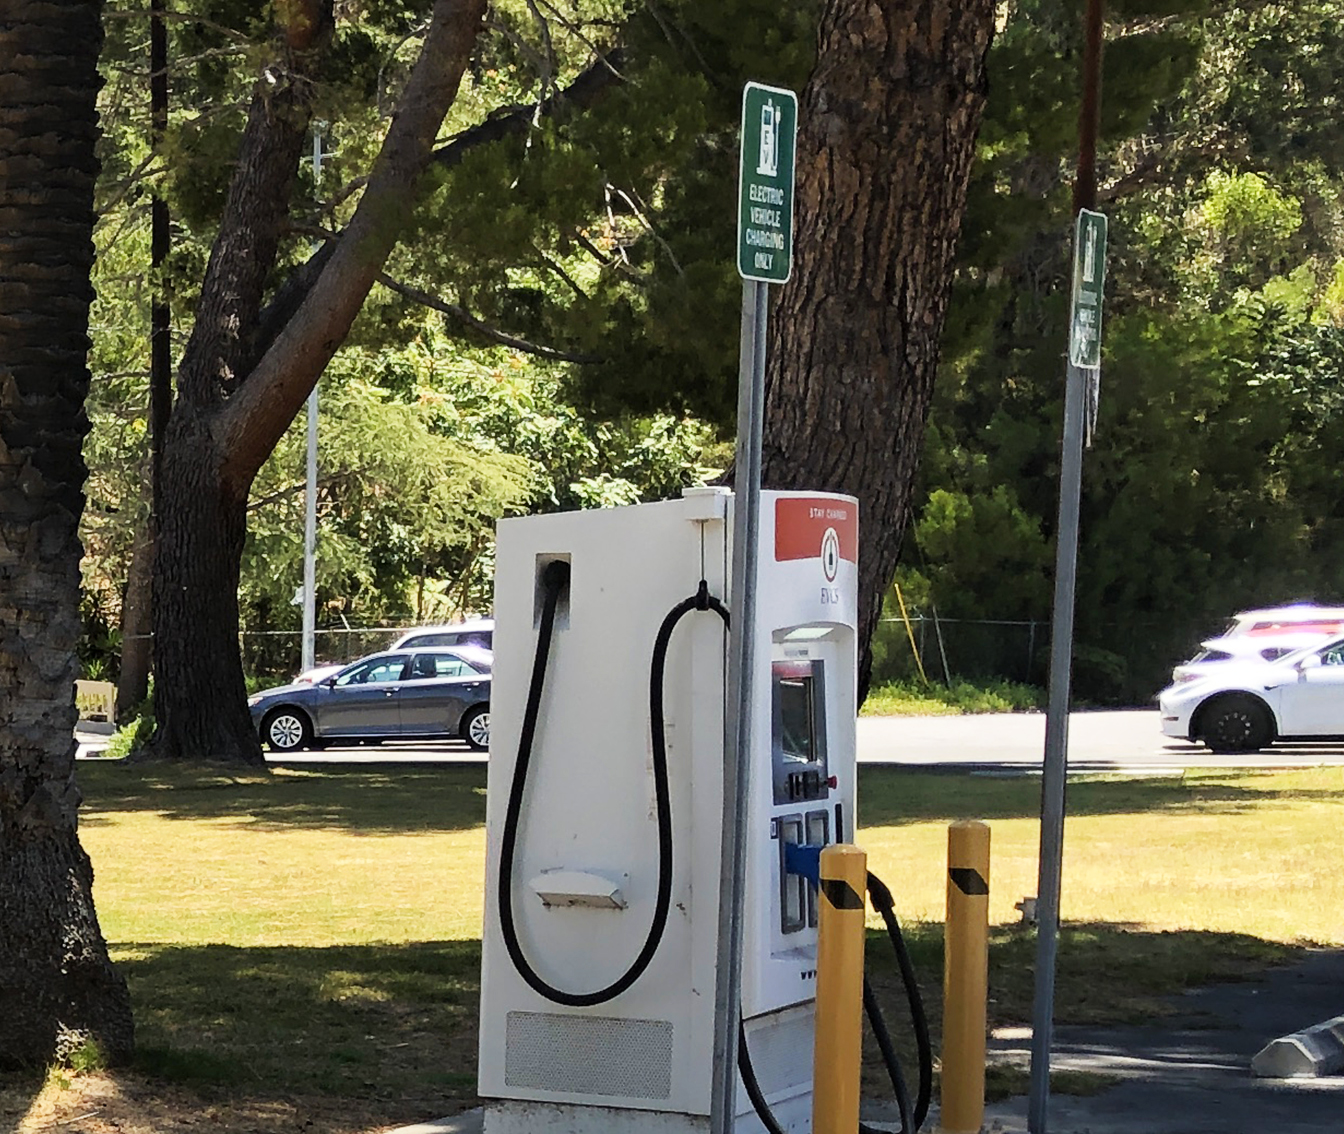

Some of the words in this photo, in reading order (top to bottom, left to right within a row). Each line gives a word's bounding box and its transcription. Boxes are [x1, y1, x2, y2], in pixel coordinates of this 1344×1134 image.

[749, 183, 784, 206] ELECTRIC
[750, 206, 781, 228] VEHICLE
[745, 228, 784, 250] CHARGING
[754, 252, 773, 270] ONLY
[809, 507, 824, 518] STAY
[821, 587, 839, 604] EVCS
